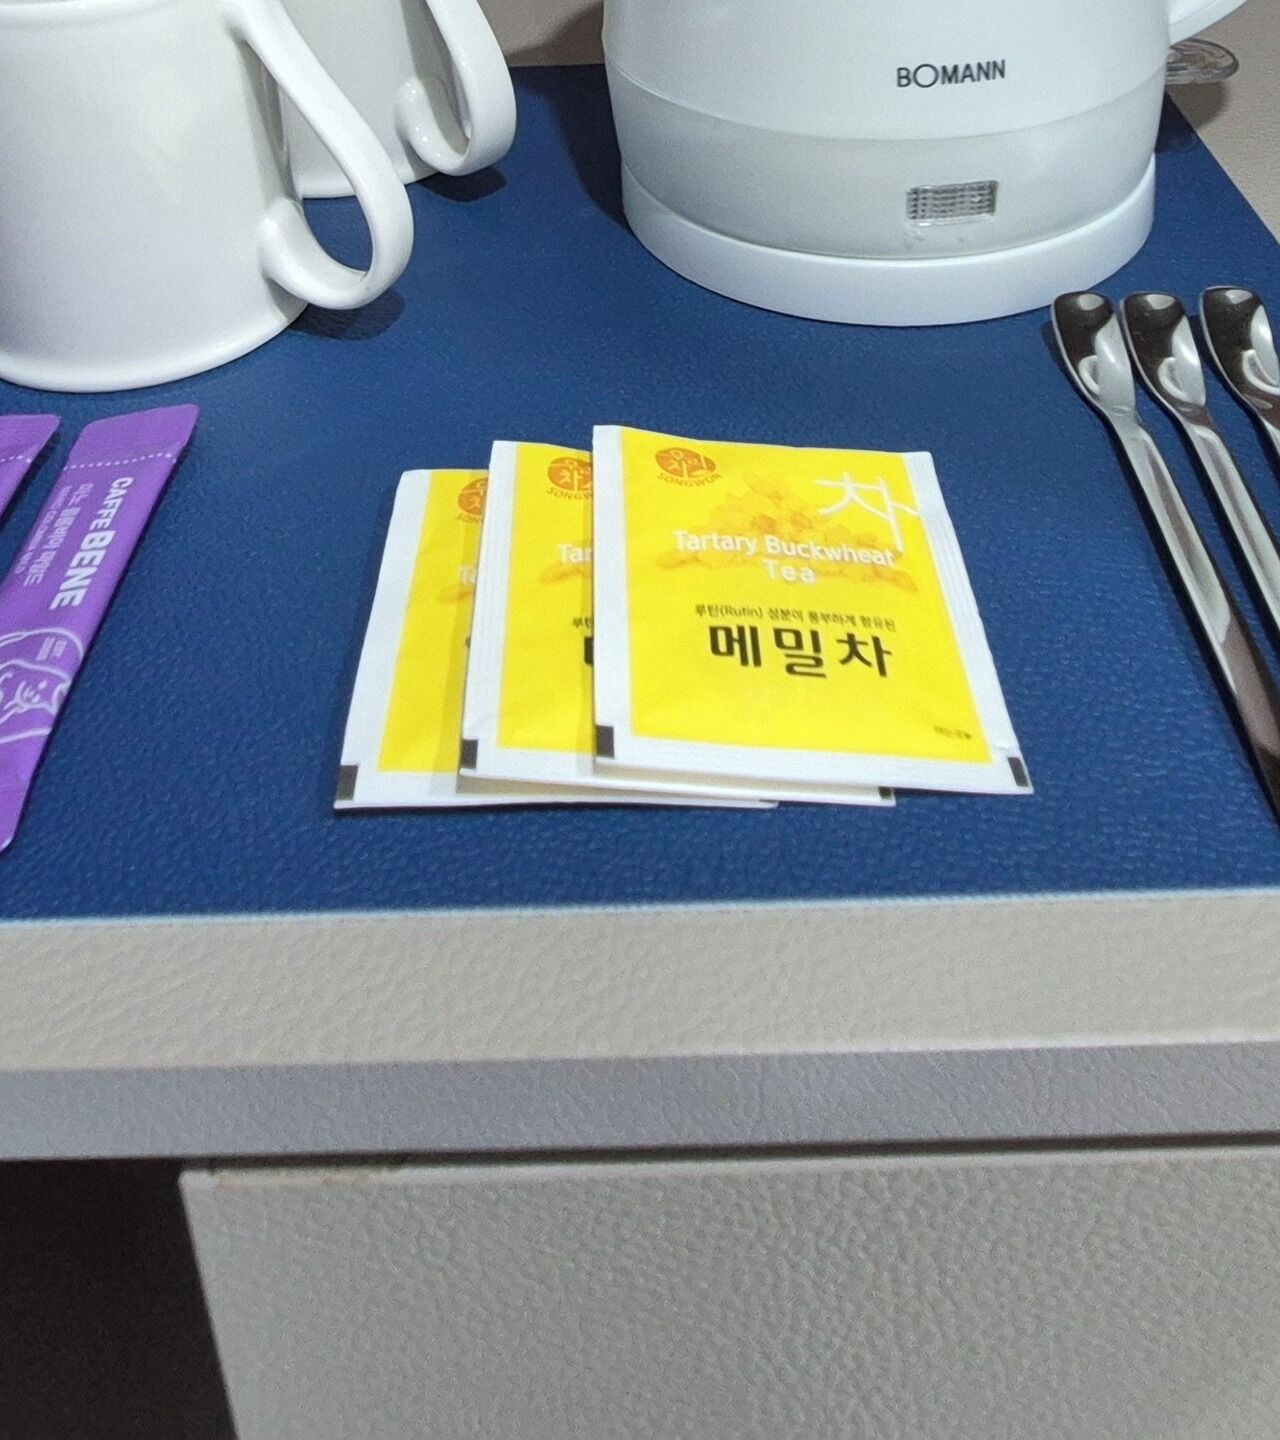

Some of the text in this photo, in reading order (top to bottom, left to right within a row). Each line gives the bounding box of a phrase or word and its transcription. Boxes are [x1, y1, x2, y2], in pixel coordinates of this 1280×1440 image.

[896, 59, 1006, 89] BOMANN
[89, 477, 134, 530] CAFFE
[814, 471, 921, 553] 차
[49, 530, 116, 610] BENE
[672, 529, 896, 567] Tartary Buckwheat
[763, 559, 817, 584] Tea
[709, 624, 893, 678] 메밀차
